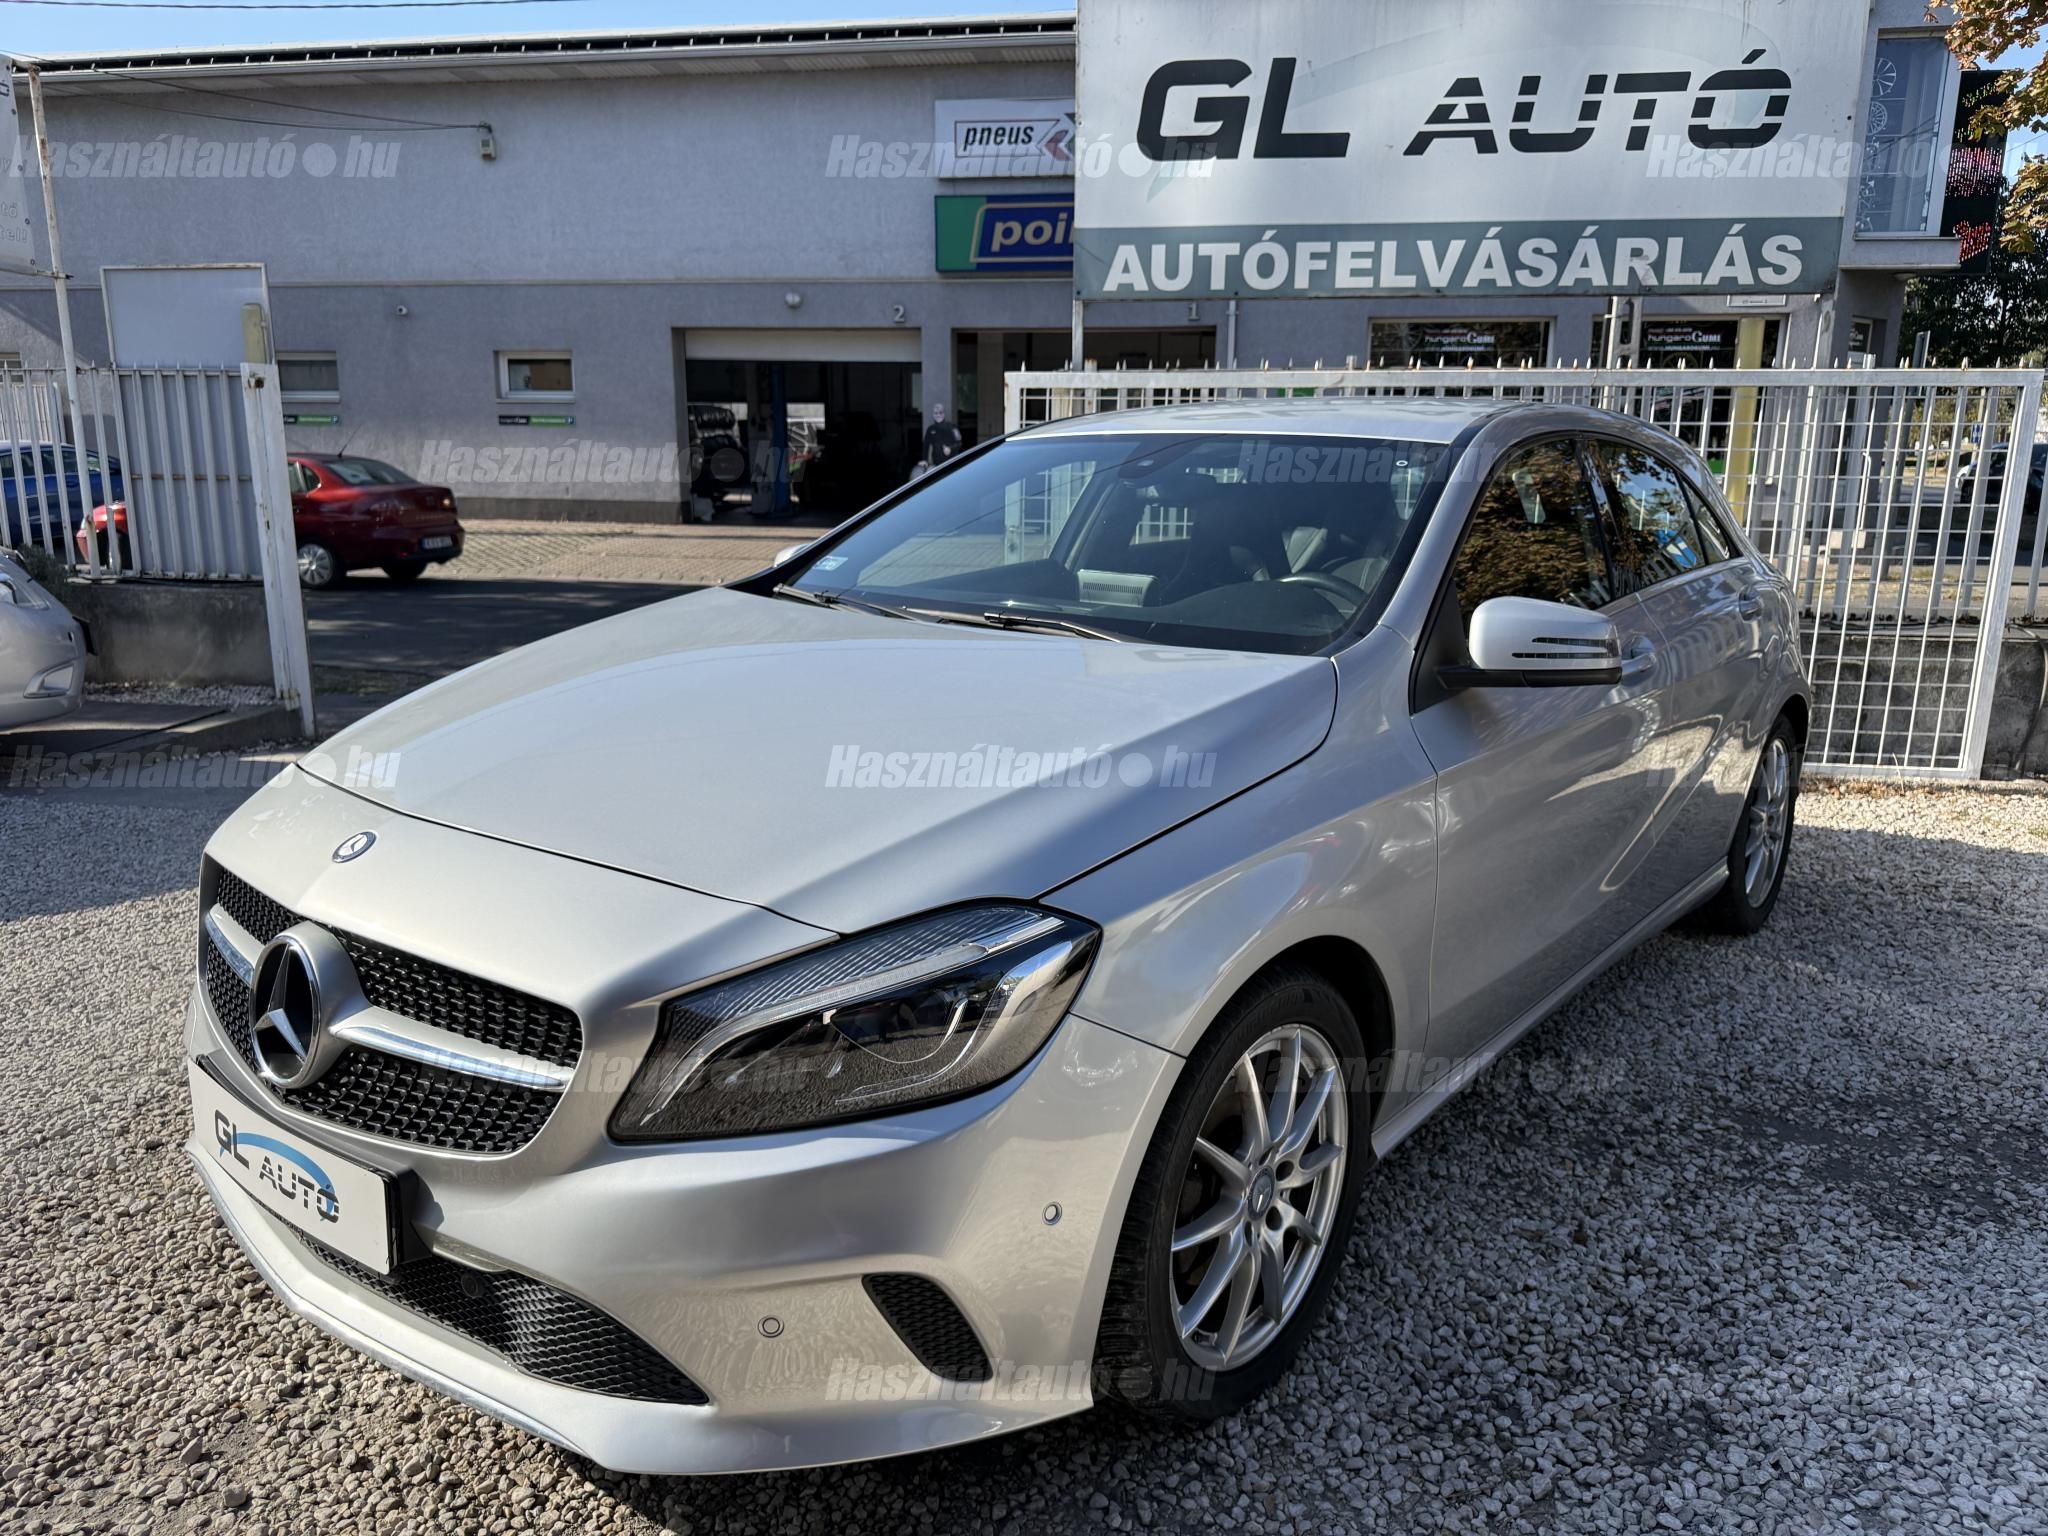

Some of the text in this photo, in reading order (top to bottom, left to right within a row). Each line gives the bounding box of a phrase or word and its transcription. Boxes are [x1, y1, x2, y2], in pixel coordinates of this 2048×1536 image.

[1136, 48, 1792, 162] GL AUTÓ
[963, 125, 1035, 152] pneus
[1102, 223, 1803, 293] AUTÓFELVÁSÁRLÁS
[893, 305, 906, 323] 2
[1187, 302, 1200, 320] 1
[214, 1109, 250, 1170] GL
